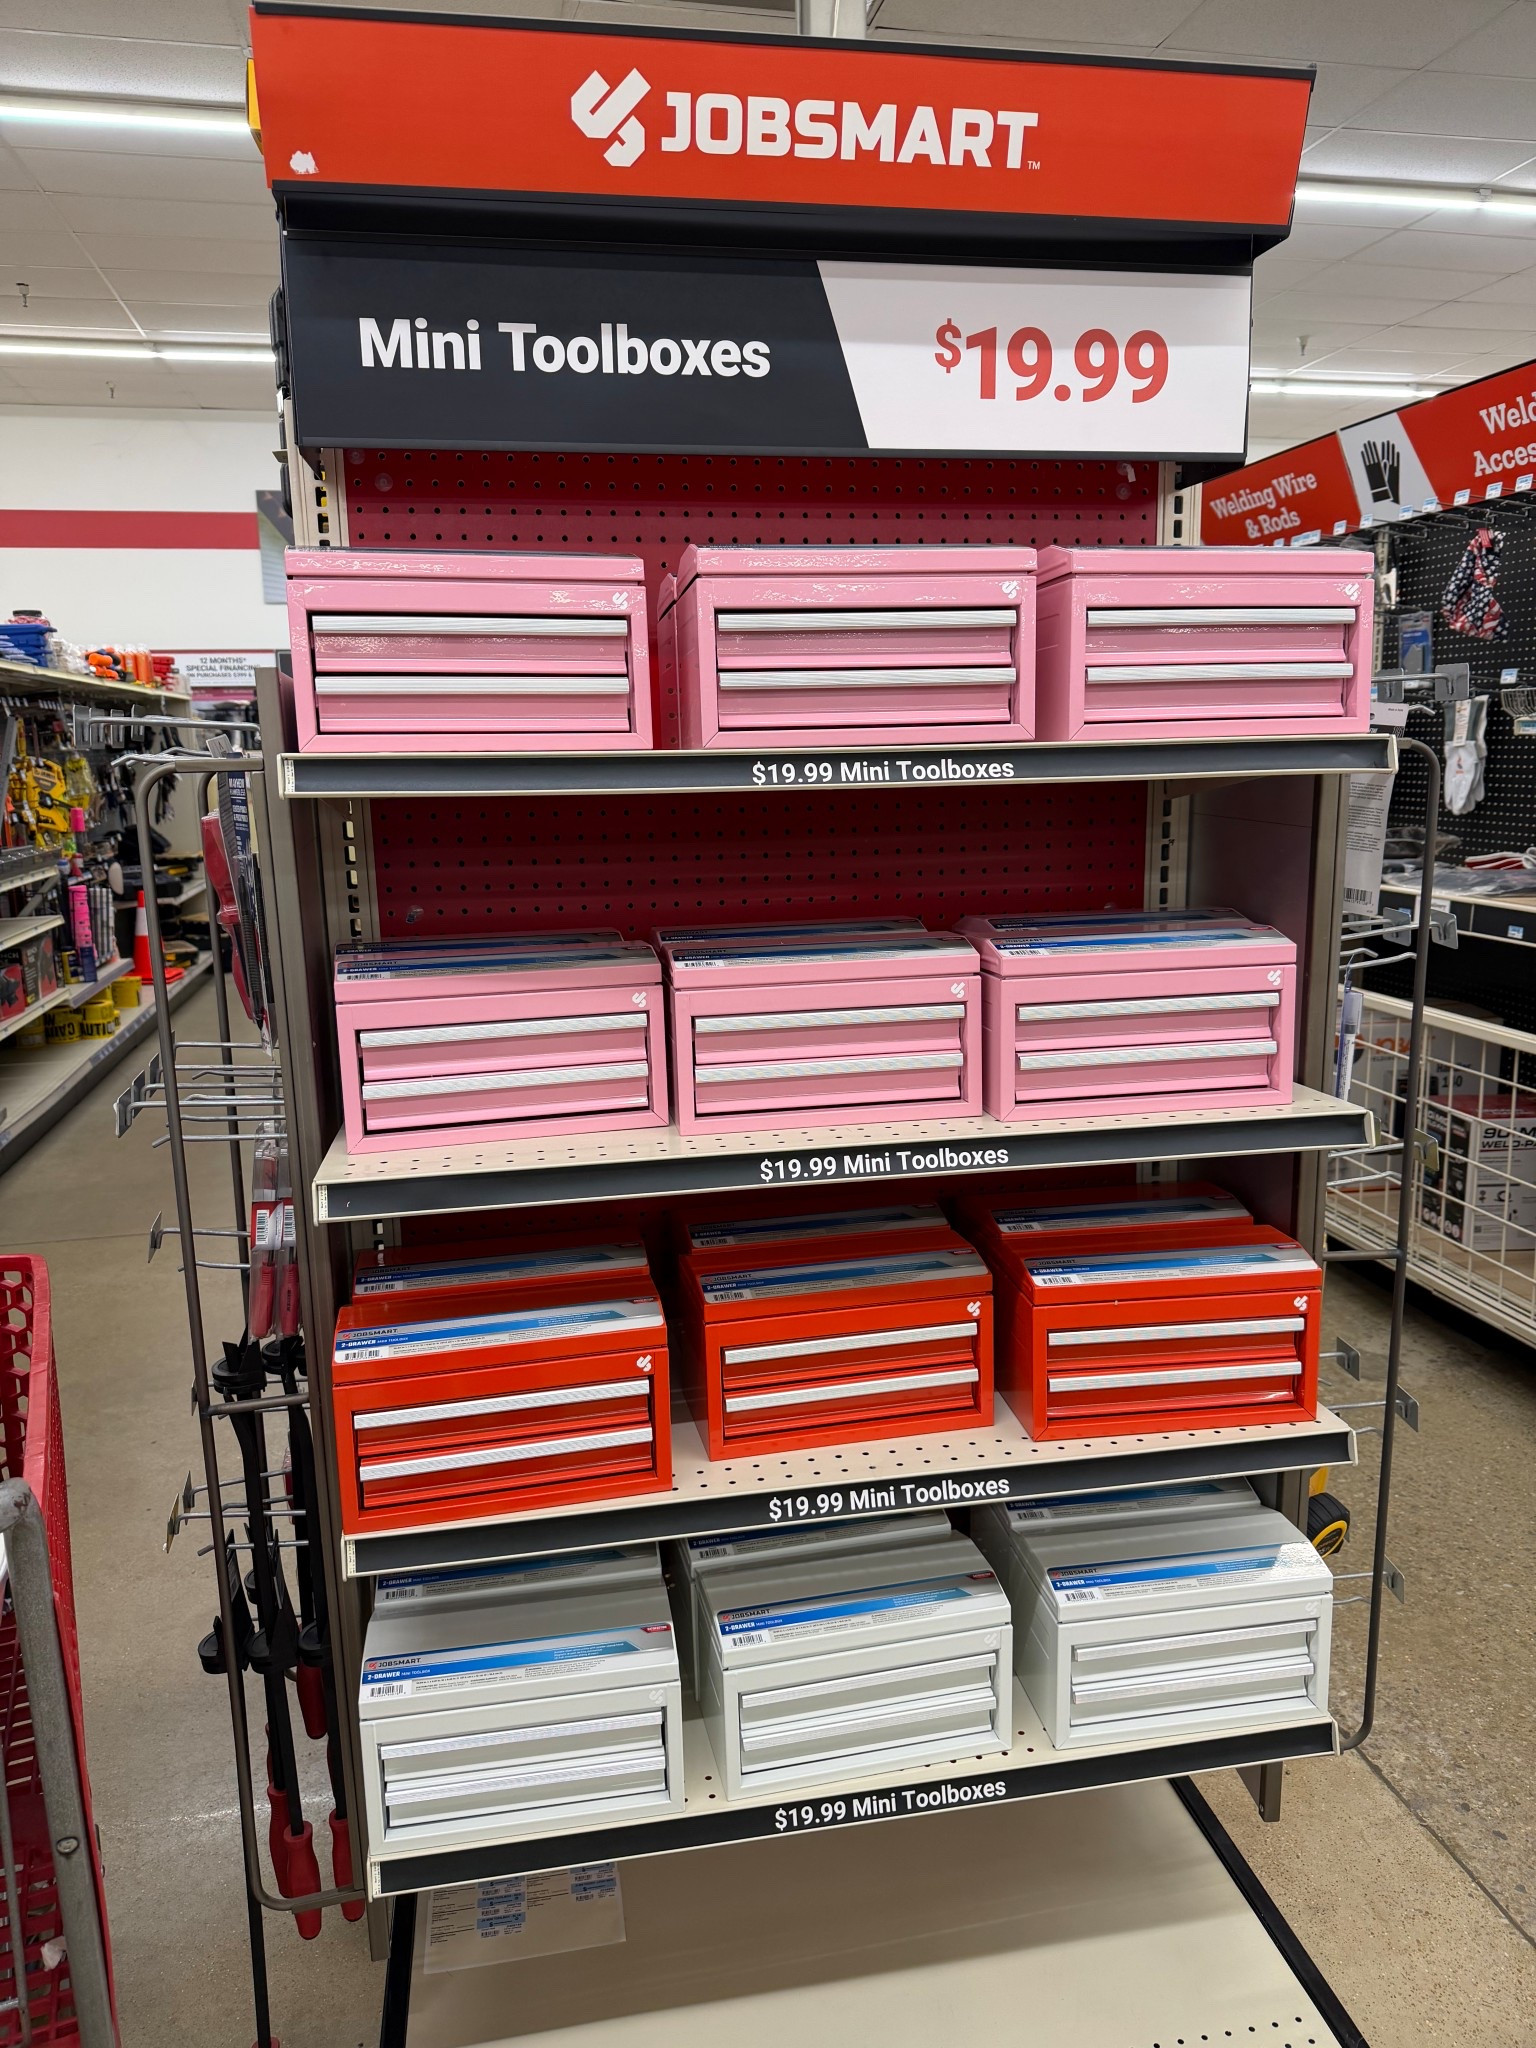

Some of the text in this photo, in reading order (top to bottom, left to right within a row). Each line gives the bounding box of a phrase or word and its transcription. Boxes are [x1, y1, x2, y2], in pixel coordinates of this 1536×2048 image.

[660, 91, 1039, 169] JOBSMART
[358, 317, 771, 378] Mini Toolboxes
[934, 318, 1169, 403] $19.99
[1209, 472, 1318, 519] Welding Wire
[1245, 505, 1301, 539] & Rods
[186, 664, 218, 672] SPECIAL
[752, 759, 1015, 786] $19.99 Mini Toolboxes
[1441, 1075, 1463, 1088] 10
[1482, 1140, 1536, 1149] WELD-P
[759, 1148, 1009, 1182] $19.99 Mini Toolboxes
[352, 1328, 398, 1338] JOBSMART
[341, 1339, 377, 1348] 2-DRAWER
[769, 1478, 1010, 1522] $19.99 Mini Toolboxes
[1060, 1568, 1098, 1576] JOBSMART
[1056, 1579, 1086, 1588] 2-DRAWER
[731, 1608, 771, 1620] JOBSMART
[724, 1622, 756, 1632] 2-DRAWER
[378, 1657, 422, 1668] JOBSMART
[367, 1671, 400, 1681] 2-DRAWER
[774, 1780, 1007, 1831] $19.99 Mini Toolboxes
